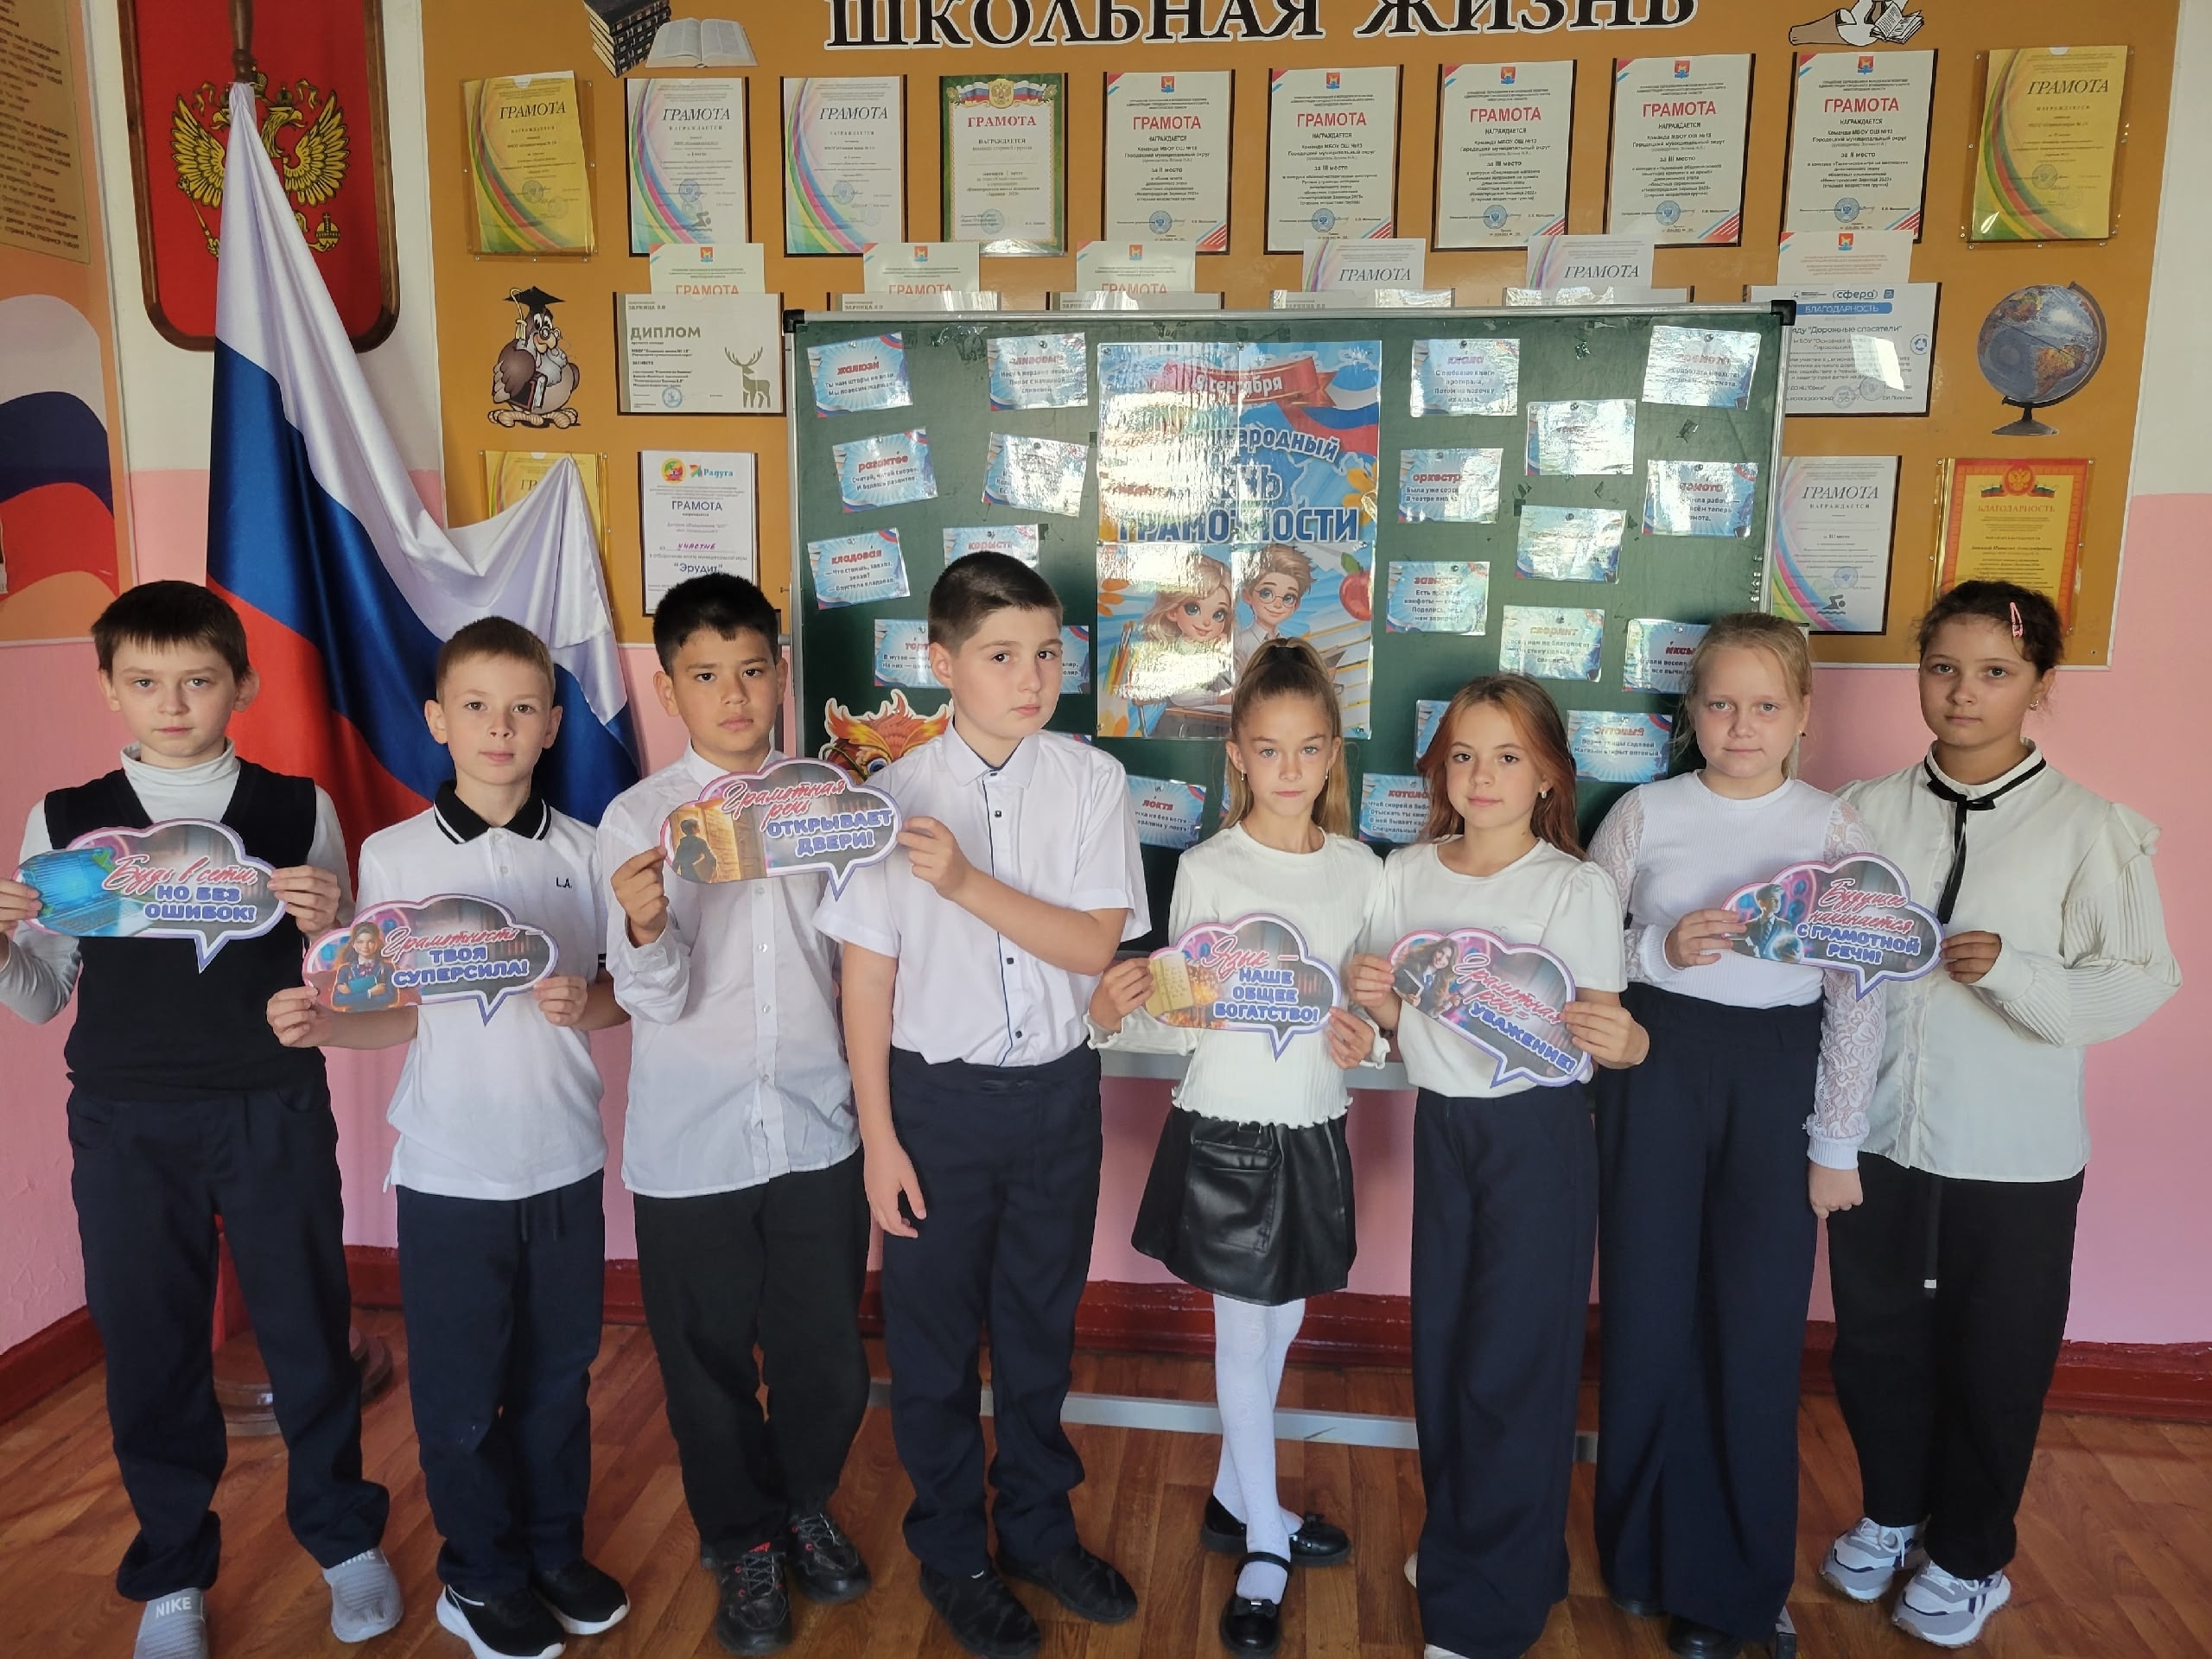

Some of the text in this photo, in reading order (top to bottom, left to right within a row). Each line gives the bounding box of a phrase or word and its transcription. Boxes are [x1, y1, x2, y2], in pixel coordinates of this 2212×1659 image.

[825, 0, 1326, 47] ШКОЛЬНАЯ
[2027, 79, 2109, 96] ГРАМОТА
[499, 101, 566, 119] ГРАМОТА
[819, 106, 888, 120] ГРАМОТА
[1643, 100, 1716, 118] ГРАМОТА
[1824, 98, 1899, 113] ГРАМОТА
[662, 108, 730, 121] ГРАМОТА
[968, 116, 1036, 127] ГРАМОТА
[1133, 116, 1201, 130] ГРАМОТА
[1297, 112, 1367, 127] ГРАМОТА
[1470, 107, 1541, 123] ГРАМОТА
[1338, 268, 1411, 283] ГРАМОТА
[1564, 265, 1639, 278] ГРАМОТА
[676, 285, 739, 295] ГРАМОТА
[889, 283, 953, 295] ГРАМОТА
[1102, 283, 1168, 294] ГРАМОТА
[1837, 289, 1875, 300] сфера
[631, 327, 701, 340] ДИПЛОМ
[1808, 326, 1855, 334] "Дорожные
[703, 468, 734, 478] Радуга
[1413, 474, 1460, 483] оркестр
[1802, 486, 1878, 499] ГРАМОТА
[671, 501, 722, 511] ГРАМОТА
[1117, 507, 1360, 543] ГРАМООСТИ
[831, 550, 881, 564] кладовая
[721, 779, 847, 820] Грамотная
[1388, 790, 1428, 798] катало
[760, 799, 810, 832] речь
[767, 810, 893, 837] ОТКРЫВАЕТ
[797, 831, 874, 857] ДВЕРИ!
[103, 855, 174, 895] Будь
[197, 866, 257, 885] сети,
[556, 876, 573, 889] L.A.
[156, 885, 240, 902] НО БЕЗ
[1819, 879, 1907, 912] Будущее
[144, 904, 257, 922] ОШИБОК!
[1808, 910, 1914, 933] начинается
[382, 927, 518, 962] Грамотность
[1797, 924, 1921, 955] С ГРАМОТНОЙ
[430, 947, 487, 964] ТВОЯ
[1202, 935, 1269, 982] Язык
[1827, 944, 1883, 964] РЕЧИ!
[392, 959, 529, 988] СУПЕРСИЛА!
[1239, 969, 1294, 985] НАШЕ
[1232, 986, 1299, 1004] ОБЩЕЕ
[1453, 954, 1562, 1024] Грамотная
[1214, 1003, 1319, 1023] БОГАТСТВО!
[1470, 1002, 1577, 1075] УВАЖЕНИЕ!
[156, 1597, 192, 1618] NIKE
